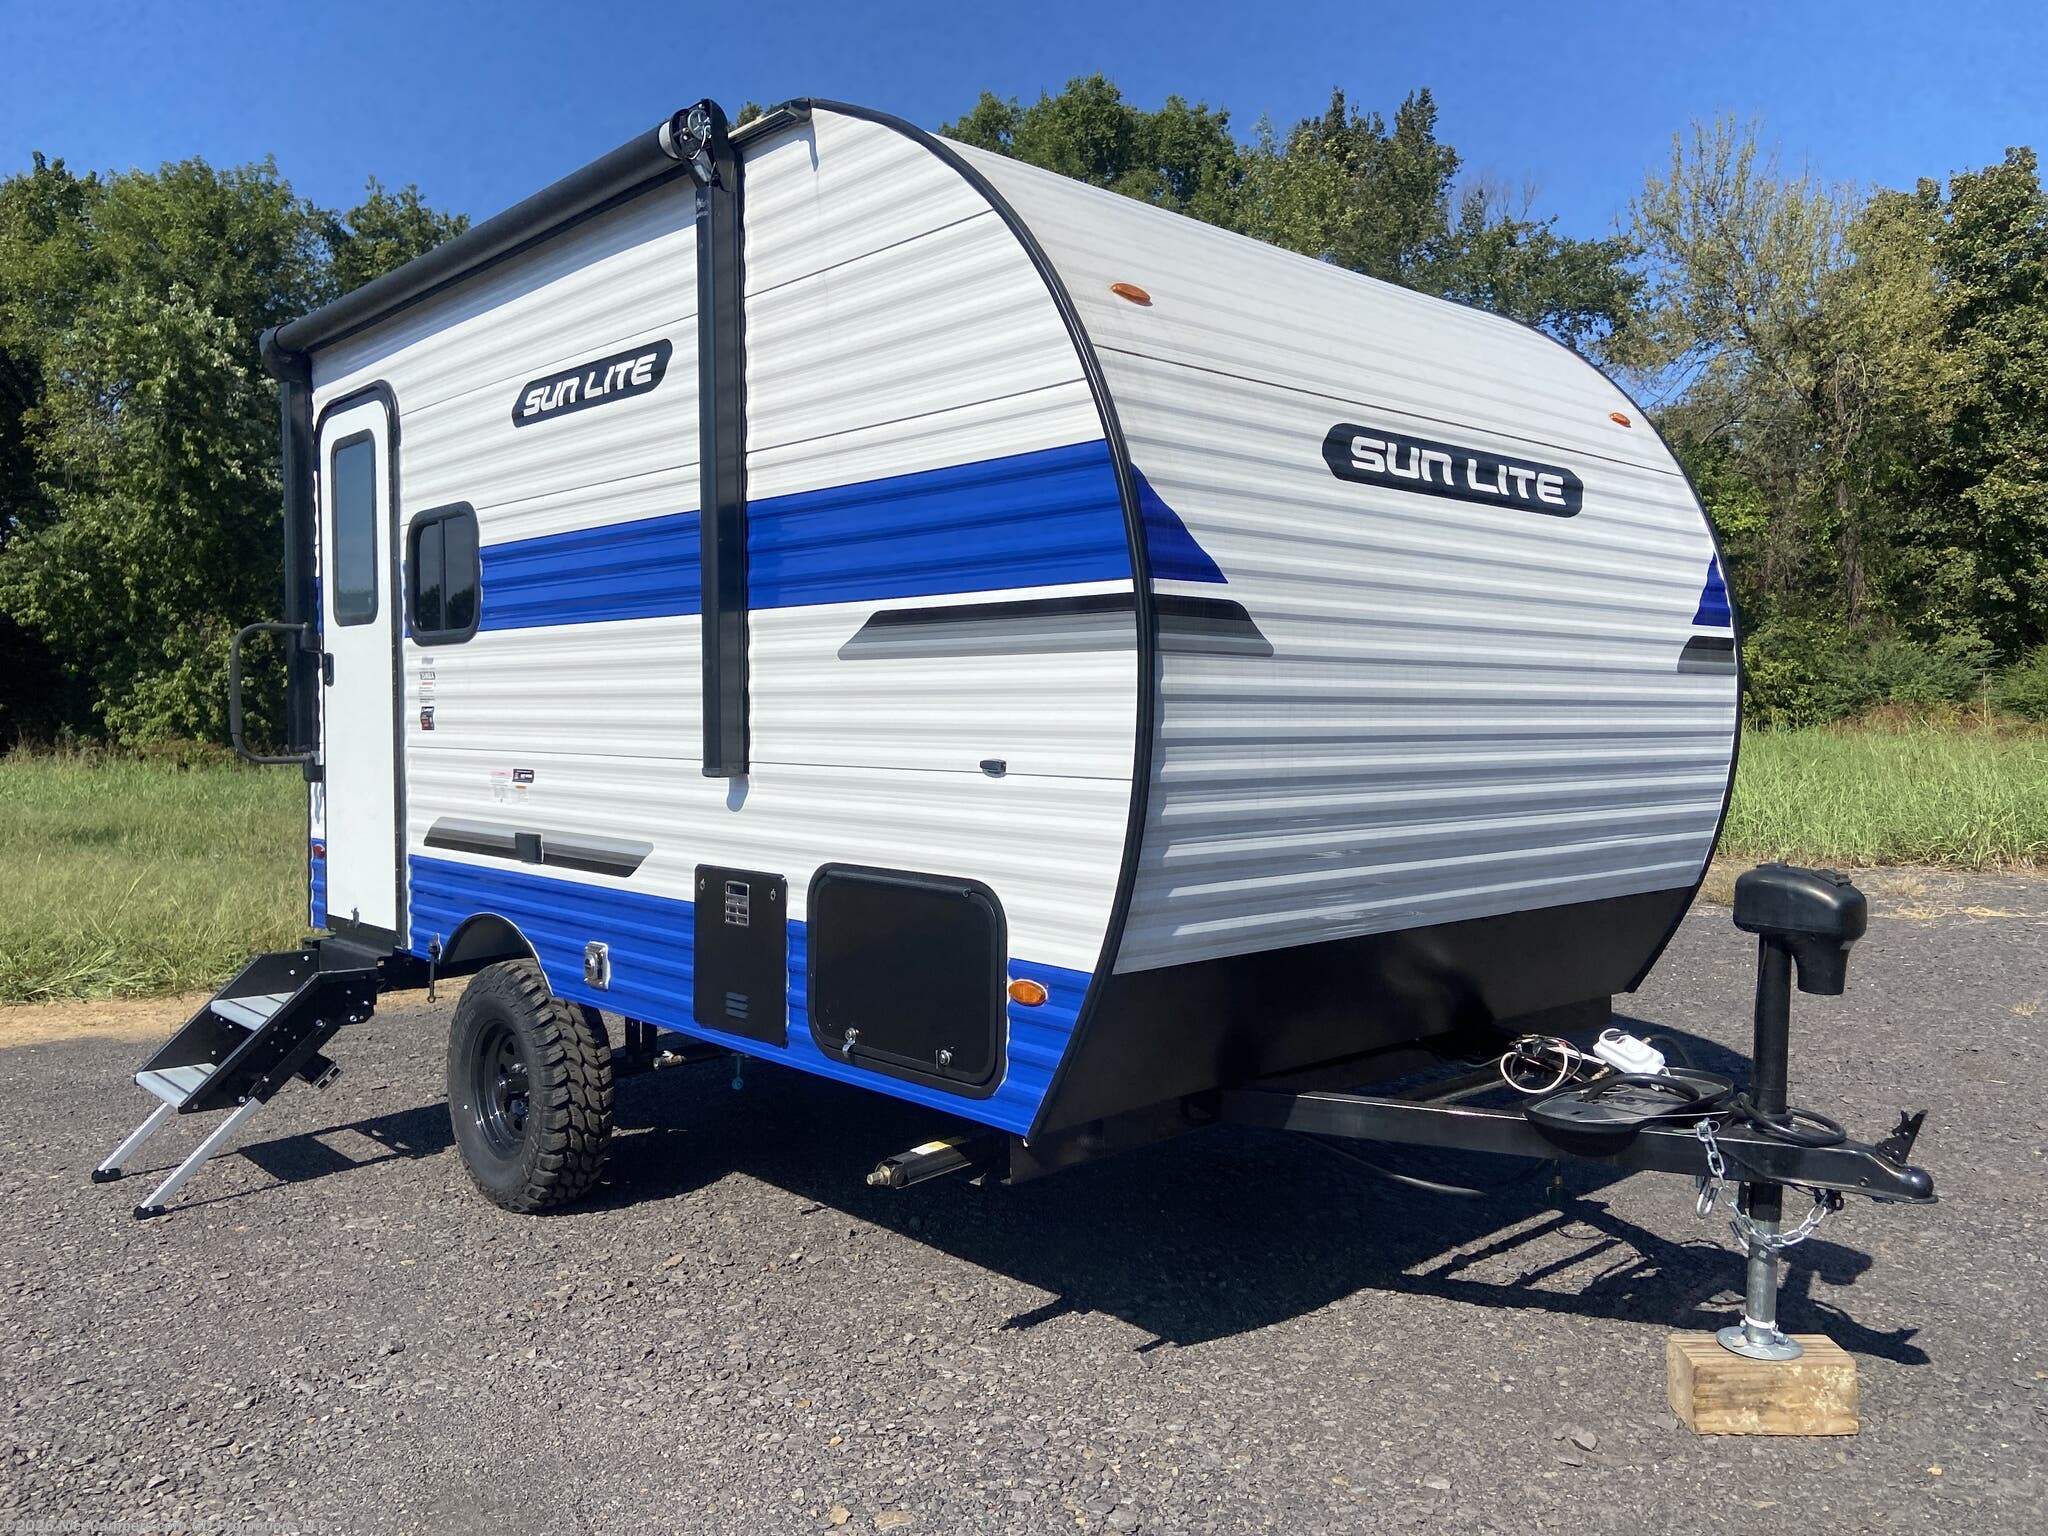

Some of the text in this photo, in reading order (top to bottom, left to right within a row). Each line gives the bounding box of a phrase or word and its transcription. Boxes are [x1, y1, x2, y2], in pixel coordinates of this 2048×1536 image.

[523, 353, 657, 416] SUN LITE
[1351, 435, 1567, 506] SUN LITE
